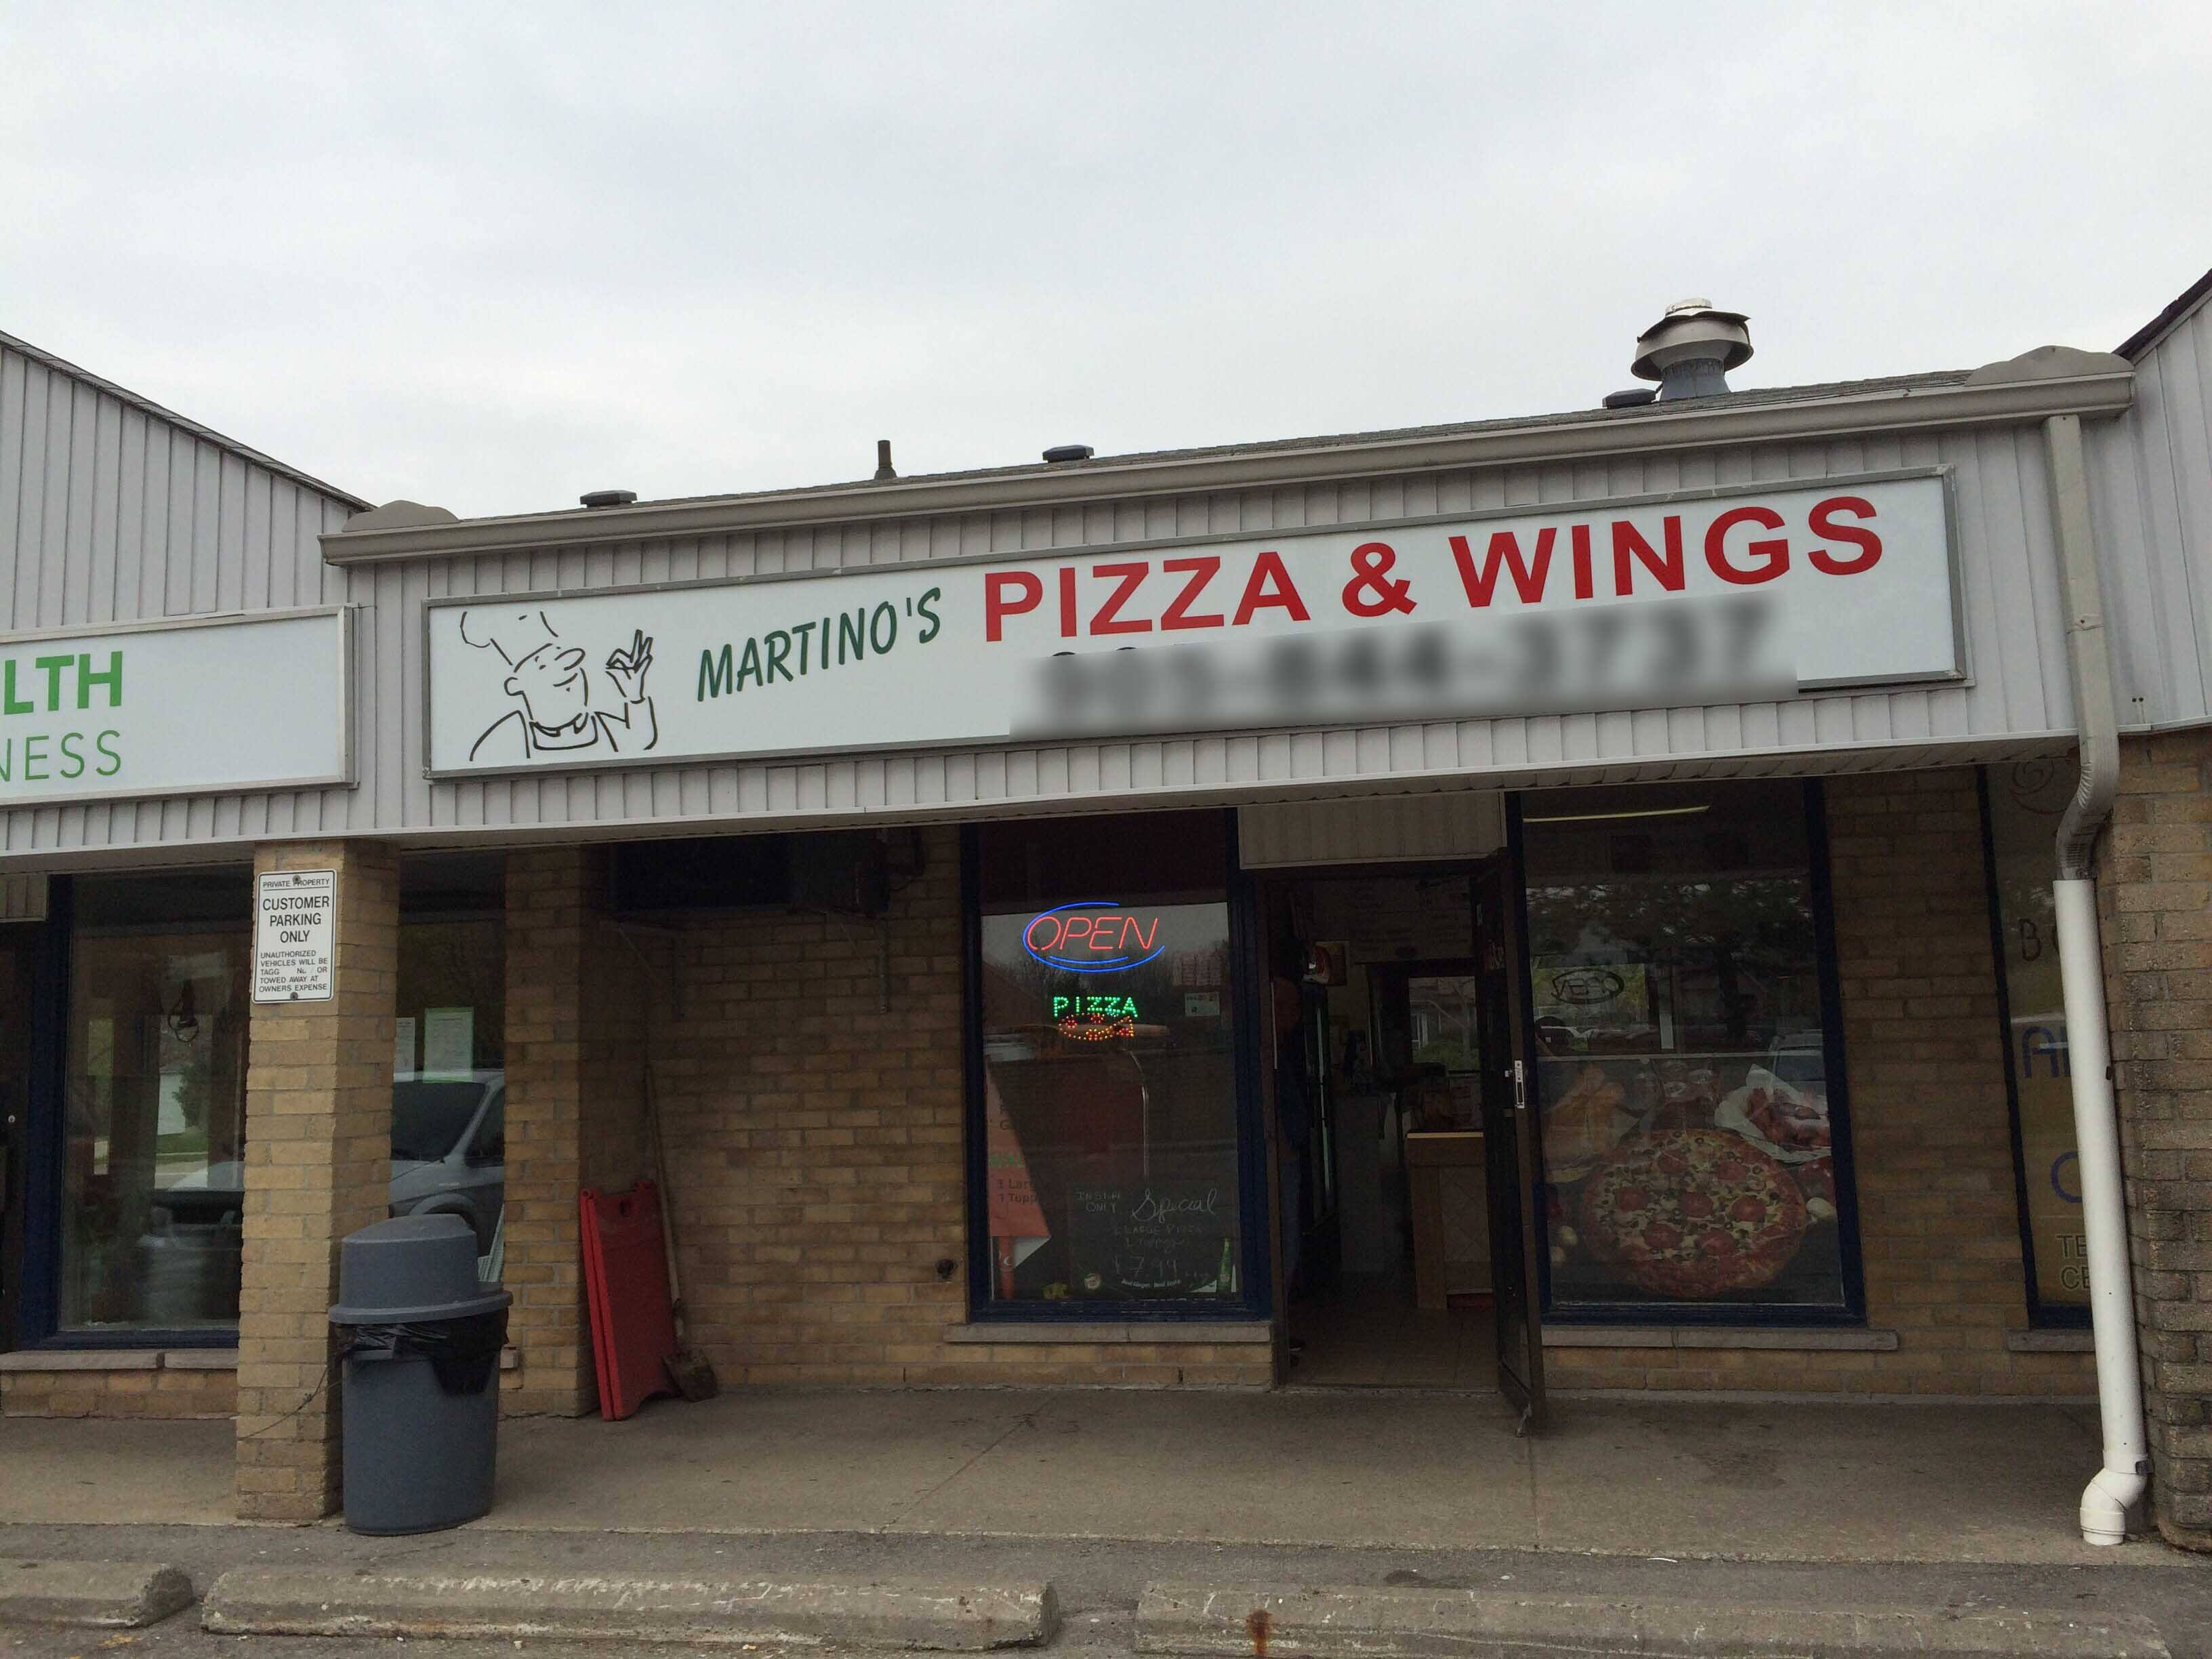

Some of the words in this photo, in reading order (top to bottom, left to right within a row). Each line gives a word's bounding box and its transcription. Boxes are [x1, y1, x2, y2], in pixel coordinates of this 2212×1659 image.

[985, 551, 1311, 642] PIZZA
[1342, 542, 1416, 617] &
[1449, 496, 1883, 609] WINGS
[697, 587, 941, 702] MARTINO'S
[3, 651, 123, 715] LTH
[262, 895, 330, 911] CUSTOMER
[270, 913, 322, 926] PARKING
[280, 930, 310, 943] ONLY
[1027, 916, 1159, 950] OPEN
[260, 949, 316, 958] UNAUTHORIZED
[260, 959, 296, 967] VEHICLES
[1053, 996, 1138, 1018] PIZZA
